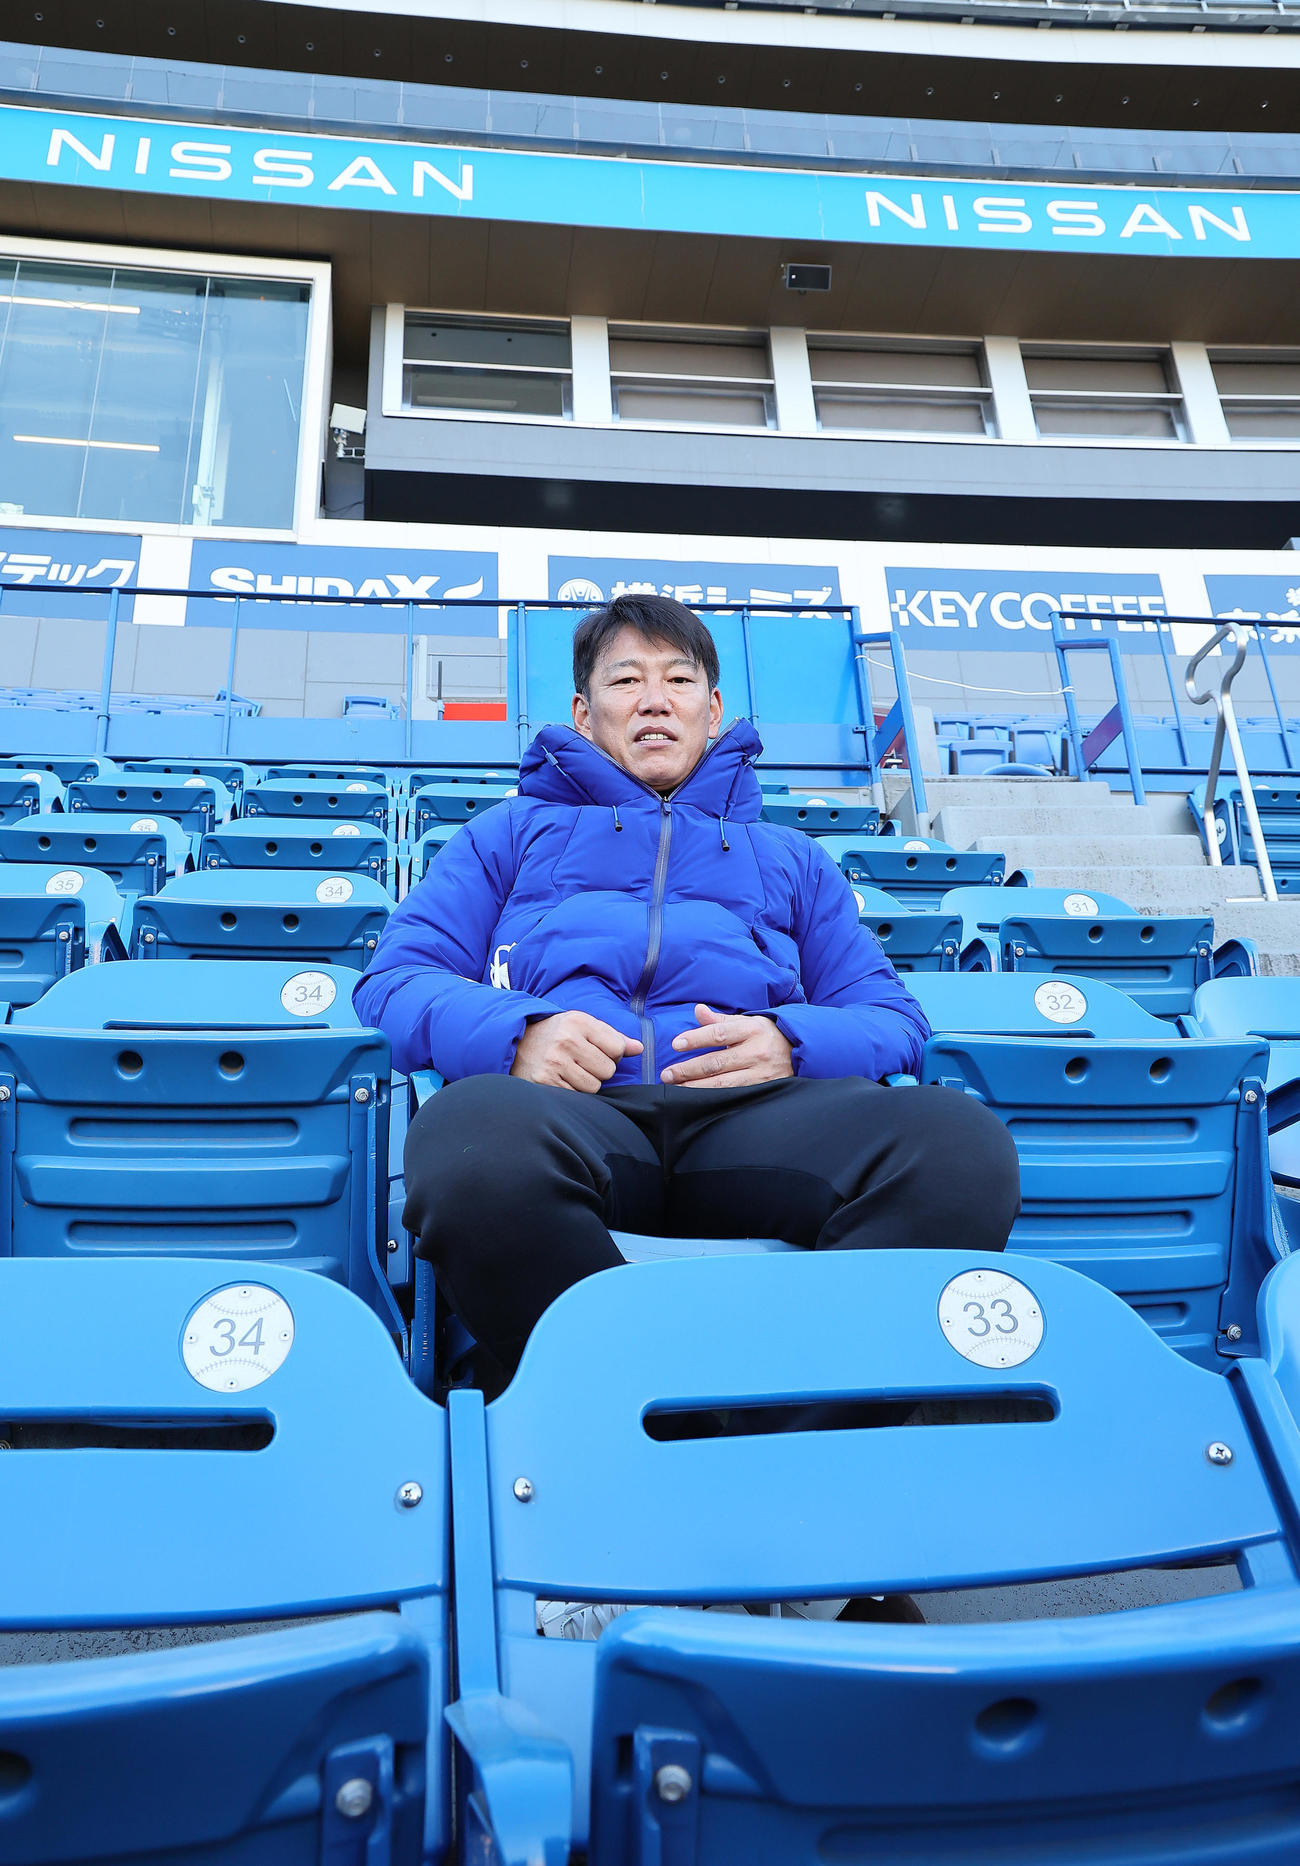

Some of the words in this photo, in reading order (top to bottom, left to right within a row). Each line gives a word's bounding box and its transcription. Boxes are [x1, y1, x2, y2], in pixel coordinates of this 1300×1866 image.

[45, 128, 475, 201] NISSAN
[864, 190, 1252, 242] NISSAN
[0, 552, 136, 595] テック
[209, 566, 442, 610] SHIDAX
[890, 589, 988, 628] KEY
[989, 591, 1171, 632] COFFEE
[54, 880, 74, 891] 35
[325, 886, 344, 897] 34
[1071, 902, 1089, 912] 31
[294, 984, 323, 1003] 34
[1046, 994, 1075, 1011] 32
[209, 1317, 266, 1357] 34
[963, 1299, 1019, 1337] 33
